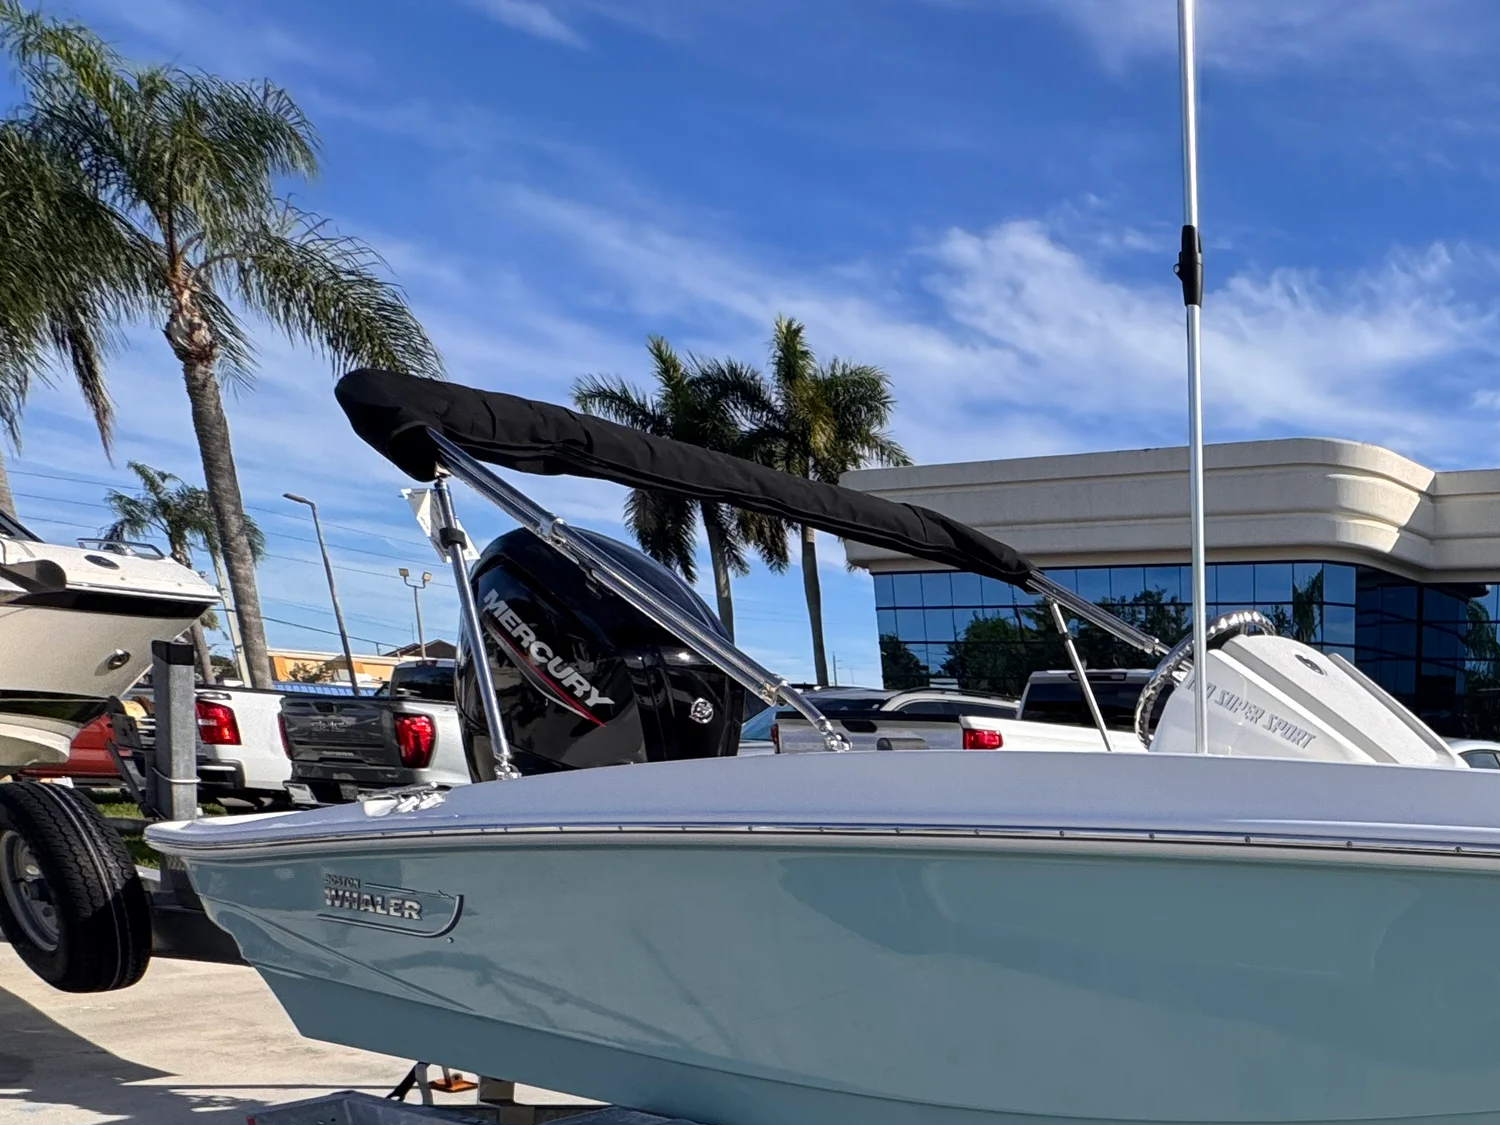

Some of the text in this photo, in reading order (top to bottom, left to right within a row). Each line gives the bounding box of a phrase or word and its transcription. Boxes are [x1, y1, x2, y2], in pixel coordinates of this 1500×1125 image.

[482, 588, 616, 708] MERCURY
[1214, 689, 1266, 725] SUPER
[1262, 713, 1317, 749] SPORT
[323, 873, 361, 889] BOSTON
[323, 886, 423, 921] WHALER
